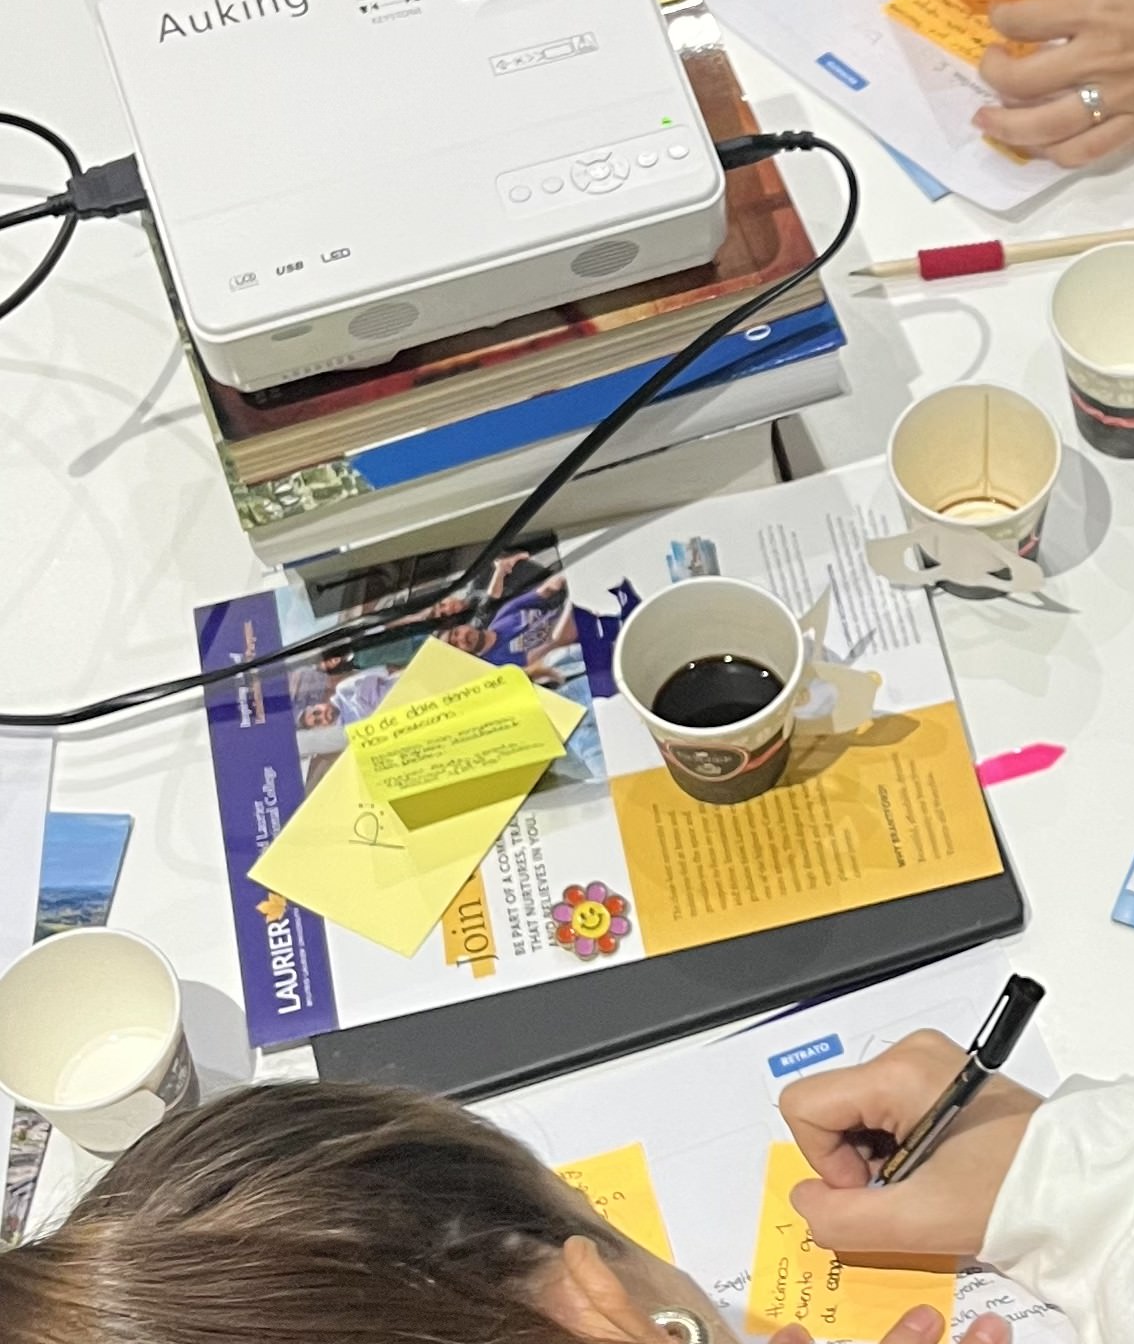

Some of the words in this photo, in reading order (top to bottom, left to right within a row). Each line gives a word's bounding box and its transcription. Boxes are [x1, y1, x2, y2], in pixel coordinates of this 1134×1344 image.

[275, 260, 304, 276] USB
[320, 247, 351, 263] LED
[531, 847, 542, 862] IN
[503, 887, 516, 904] OF
[514, 845, 536, 916] NURTURES,
[533, 863, 553, 916] BELIEVES
[456, 898, 500, 968] Join
[506, 907, 522, 937] PART
[527, 920, 542, 951] THAT
[272, 917, 302, 1016] LAURIER
[779, 1041, 830, 1066] RETRATO
[794, 1269, 816, 1321] evento
[820, 1307, 837, 1324] de
